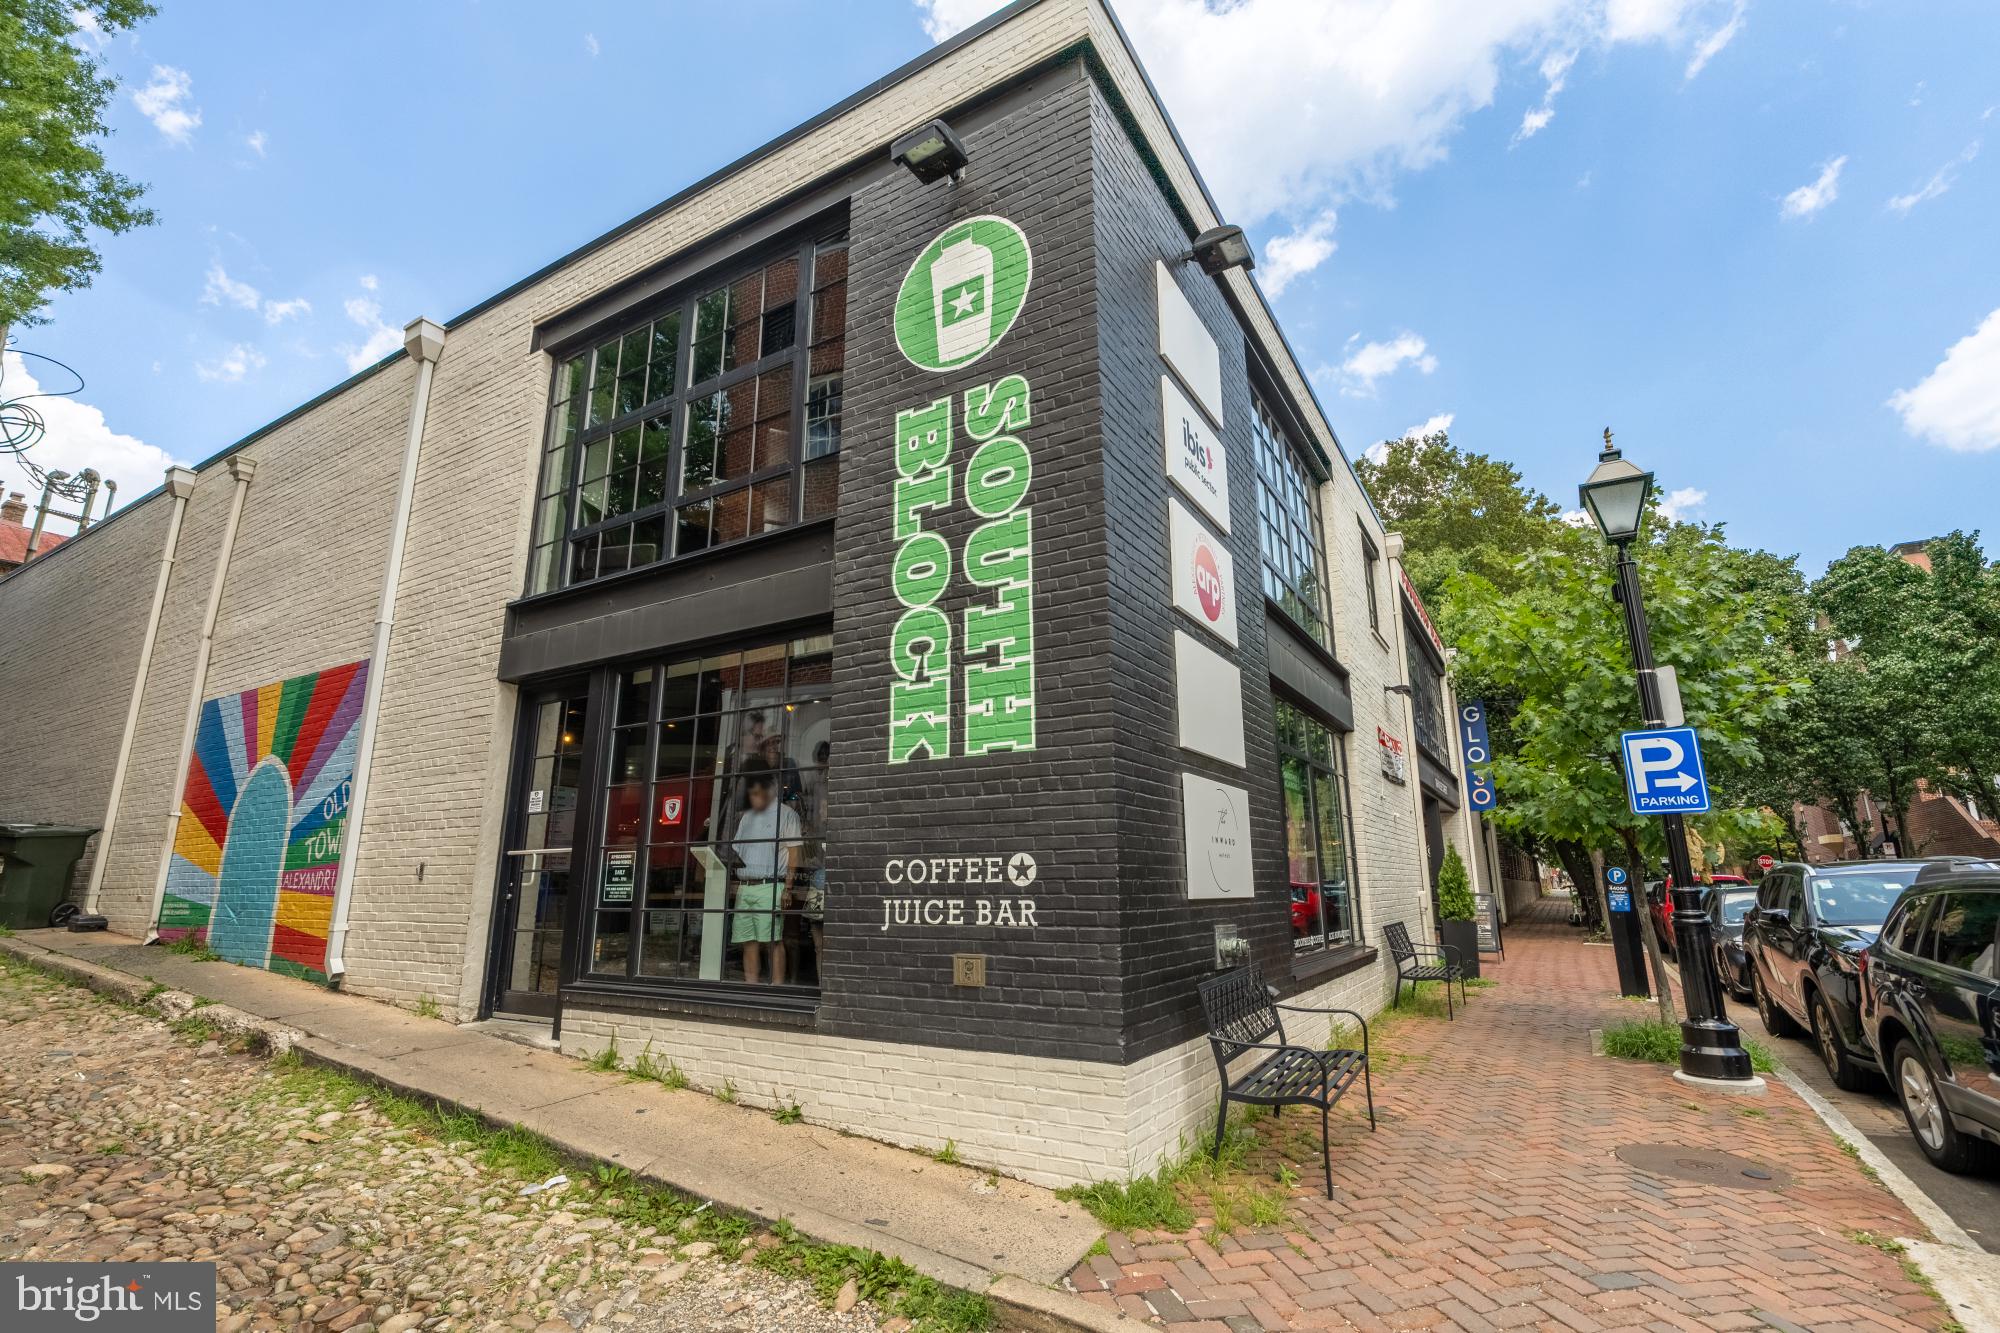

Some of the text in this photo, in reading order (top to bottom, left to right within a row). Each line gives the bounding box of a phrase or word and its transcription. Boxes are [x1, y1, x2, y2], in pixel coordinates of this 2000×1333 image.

[1182, 416, 1206, 468] ibis
[888, 395, 953, 765] BLOCK
[964, 374, 1036, 756] SOUTH
[1196, 564, 1220, 608] arp
[1627, 737, 1685, 794] P
[1640, 795, 1700, 807] PARKING
[282, 869, 336, 891] ALEXANDRI
[885, 857, 1003, 884] COFFEE
[1613, 870, 1622, 882] P
[881, 899, 1038, 931] JUICE BAR
